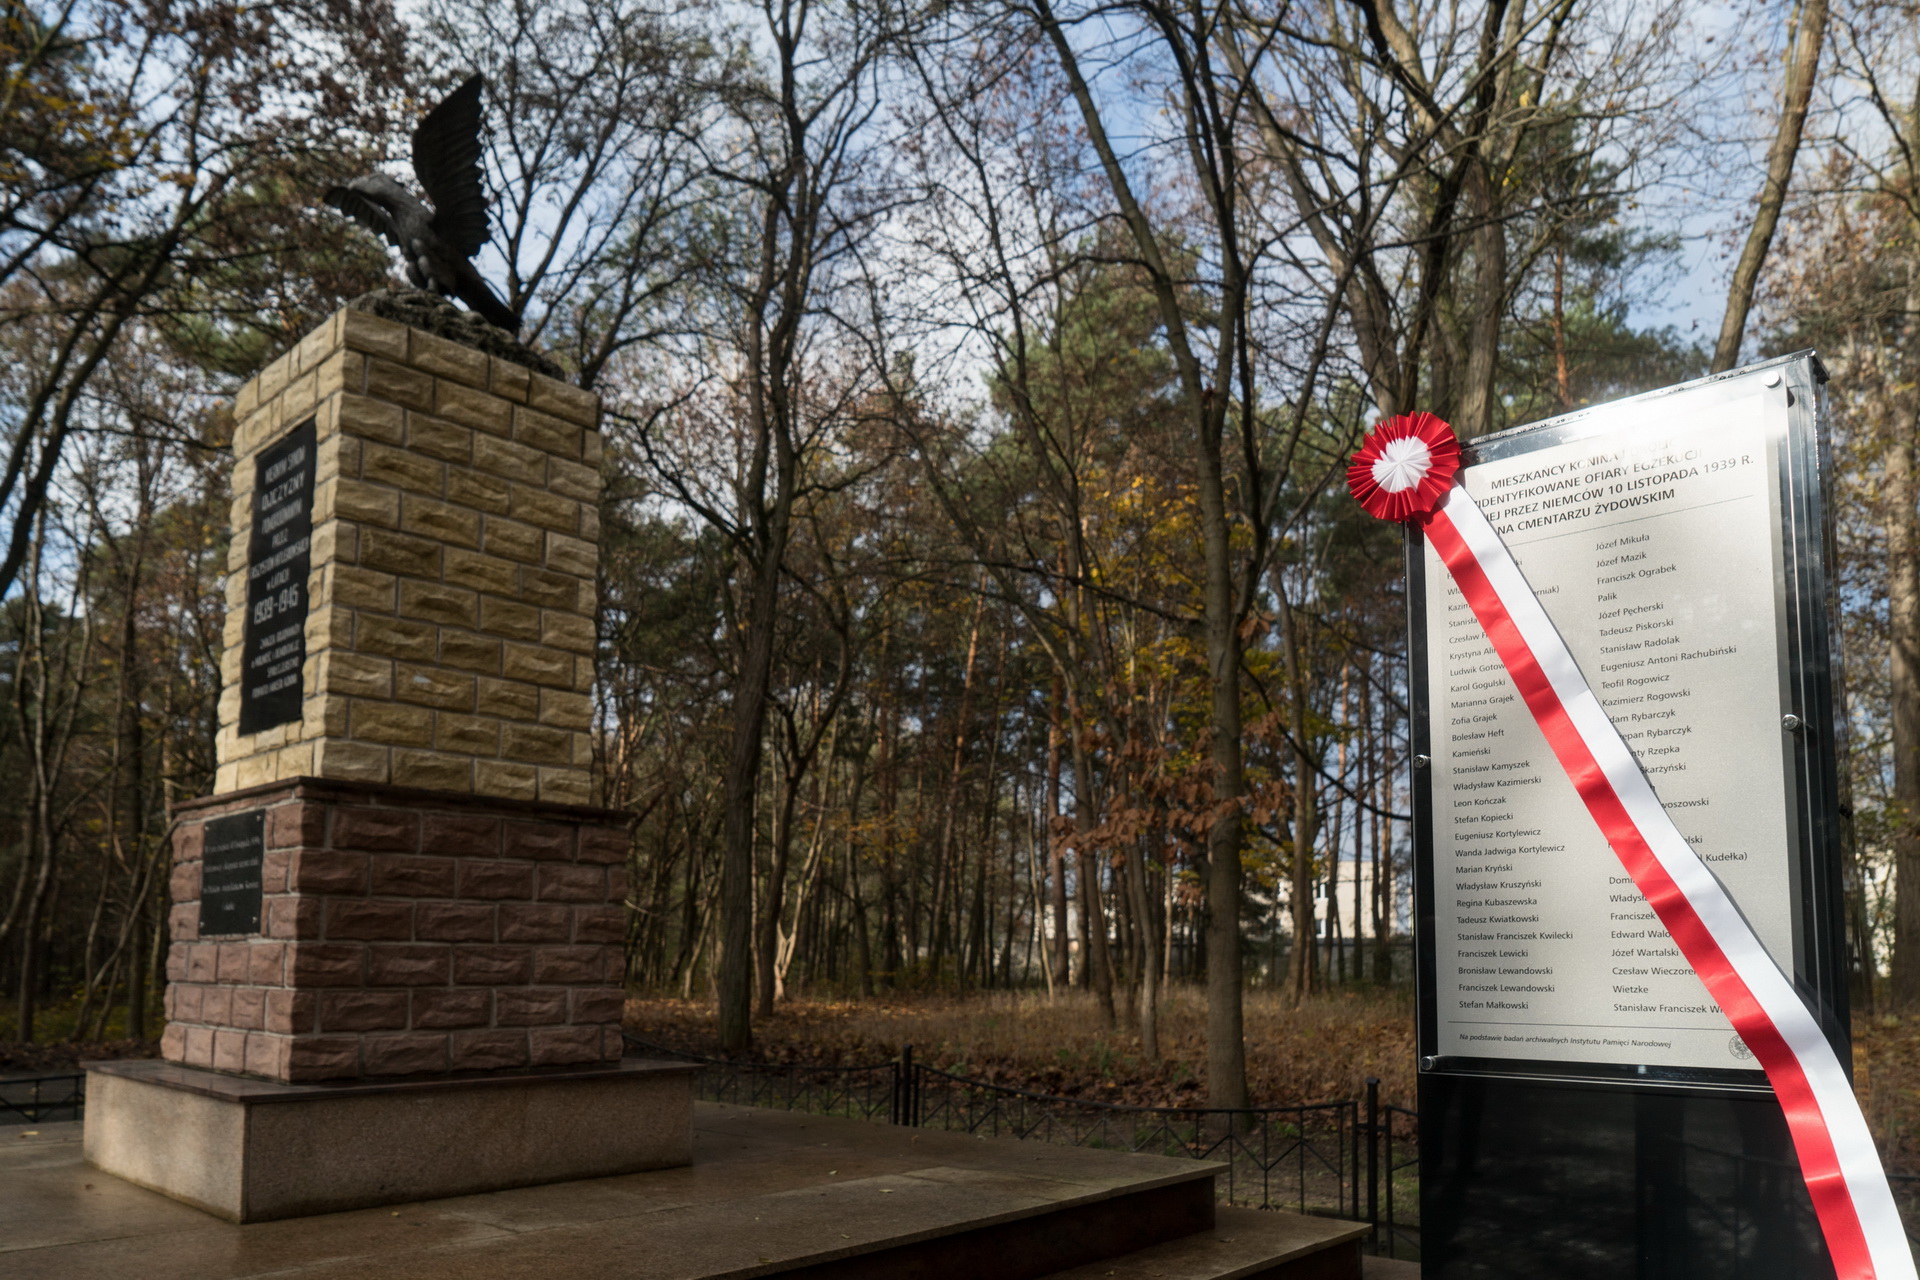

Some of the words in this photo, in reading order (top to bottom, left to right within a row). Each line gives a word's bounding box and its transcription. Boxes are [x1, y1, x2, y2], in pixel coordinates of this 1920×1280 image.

[1492, 464, 1566, 490] MIESZKAŃCY
[1475, 477, 1580, 508] IDENTYFIKOWANE
[1585, 465, 1628, 484] OFIARY
[1504, 502, 1538, 518] PRZEZ
[1543, 488, 1604, 509] NIEMCÓW
[1608, 484, 1623, 495] 10
[1628, 466, 1698, 491] LISTOPADA
[1704, 458, 1736, 473] 1939
[1742, 454, 1754, 466] R.
[1497, 524, 1514, 535] NA
[1518, 507, 1590, 530] CMENTARZU
[1594, 489, 1674, 514] ŻYDOWSKIM
[1596, 539, 1616, 550] Józef
[1620, 534, 1650, 546] Mikuła
[1596, 557, 1618, 568] Józef
[1620, 552, 1646, 563] Mazik
[1597, 572, 1636, 584] Franciszk
[1638, 564, 1676, 578] Ograbek
[1598, 592, 1617, 602] Palik
[1598, 609, 1620, 620] Józef
[1623, 602, 1664, 616] Pęcherski
[1448, 617, 1478, 628] Stanisła
[1600, 626, 1633, 636] Tadeusz
[1636, 618, 1674, 632] Piskorski
[1449, 634, 1480, 644] Czesław
[1600, 642, 1642, 654] Stanisław
[1644, 636, 1680, 648] Radolak
[1450, 650, 1482, 660] Krystyna
[1600, 660, 1644, 672] Eugeniusz
[1648, 654, 1678, 665] Antoni
[1680, 645, 1736, 660] Rachubiński
[1450, 666, 1477, 676] Ludwik
[1450, 682, 1470, 692] Karol
[1472, 678, 1506, 690] Gogulski
[1602, 680, 1624, 689] Teofil
[1626, 674, 1670, 686] Rogowicz
[1451, 698, 1487, 709] Marianna
[1490, 694, 1514, 705] Grajek
[1602, 696, 1644, 707] Kazimierz
[1646, 688, 1690, 702] Rogowski
[1452, 716, 1470, 726] Zofia
[1472, 713, 1498, 724] Grajek
[1610, 714, 1628, 724] dam
[1632, 709, 1676, 722] Rybarczyk
[1452, 731, 1485, 742] Bolesław
[1488, 729, 1504, 738] Heft
[1646, 725, 1692, 738] Rybarczyk
[1452, 746, 1490, 758] Kamieński
[1648, 746, 1680, 755] Rzepka
[1453, 764, 1490, 774] Stanisław
[1492, 760, 1530, 771] Kamyszek
[1454, 780, 1495, 791] Władysław
[1497, 776, 1542, 787] Kazimierski
[1474, 796, 1506, 806] Kończak
[1454, 815, 1478, 824] Stefan
[1481, 812, 1514, 822] Kopiecki
[1454, 831, 1493, 842] Eugeniusz
[1496, 828, 1542, 840] Kortylewicz
[1455, 848, 1482, 857] Wanda
[1484, 847, 1516, 858] Jadwiga
[1518, 844, 1565, 856] Kortylewicz
[1456, 866, 1482, 874] Marian
[1485, 864, 1512, 874] Kryński
[1456, 882, 1498, 892] Władysław
[1500, 880, 1542, 890] Kruszyński
[1456, 899, 1482, 908] Regina
[1484, 898, 1538, 906] Kubaszewska
[1457, 916, 1487, 924] Tadeusz
[1489, 914, 1539, 923] Kwiatkowski
[1610, 912, 1656, 920] Franciszek
[1458, 932, 1494, 941] Stanisław
[1496, 932, 1537, 940] Franciszek
[1540, 932, 1573, 940] Kwilecki
[1611, 930, 1644, 938] Edward
[1458, 950, 1497, 958] Franciszek
[1500, 950, 1528, 958] Lewicki
[1612, 948, 1634, 957] Józef
[1636, 948, 1679, 956] Wartalski
[1458, 966, 1496, 975] Bronisław
[1498, 967, 1553, 975] Lewandowski
[1612, 967, 1648, 975] Czesław
[1458, 984, 1498, 992] Franciszek
[1500, 984, 1555, 992] Lewandowski
[1612, 985, 1648, 994] Wietzke
[1486, 1001, 1528, 1010] Małkowski
[1614, 1004, 1656, 1012] Stanisław
[1660, 1004, 1707, 1013] Franciszek
[1526, 1036, 1568, 1044] archiwalnych
[1570, 1037, 1601, 1046] Instytutu
[1602, 1038, 1630, 1047] Pamięci
[1632, 1040, 1671, 1048] Narodowej
